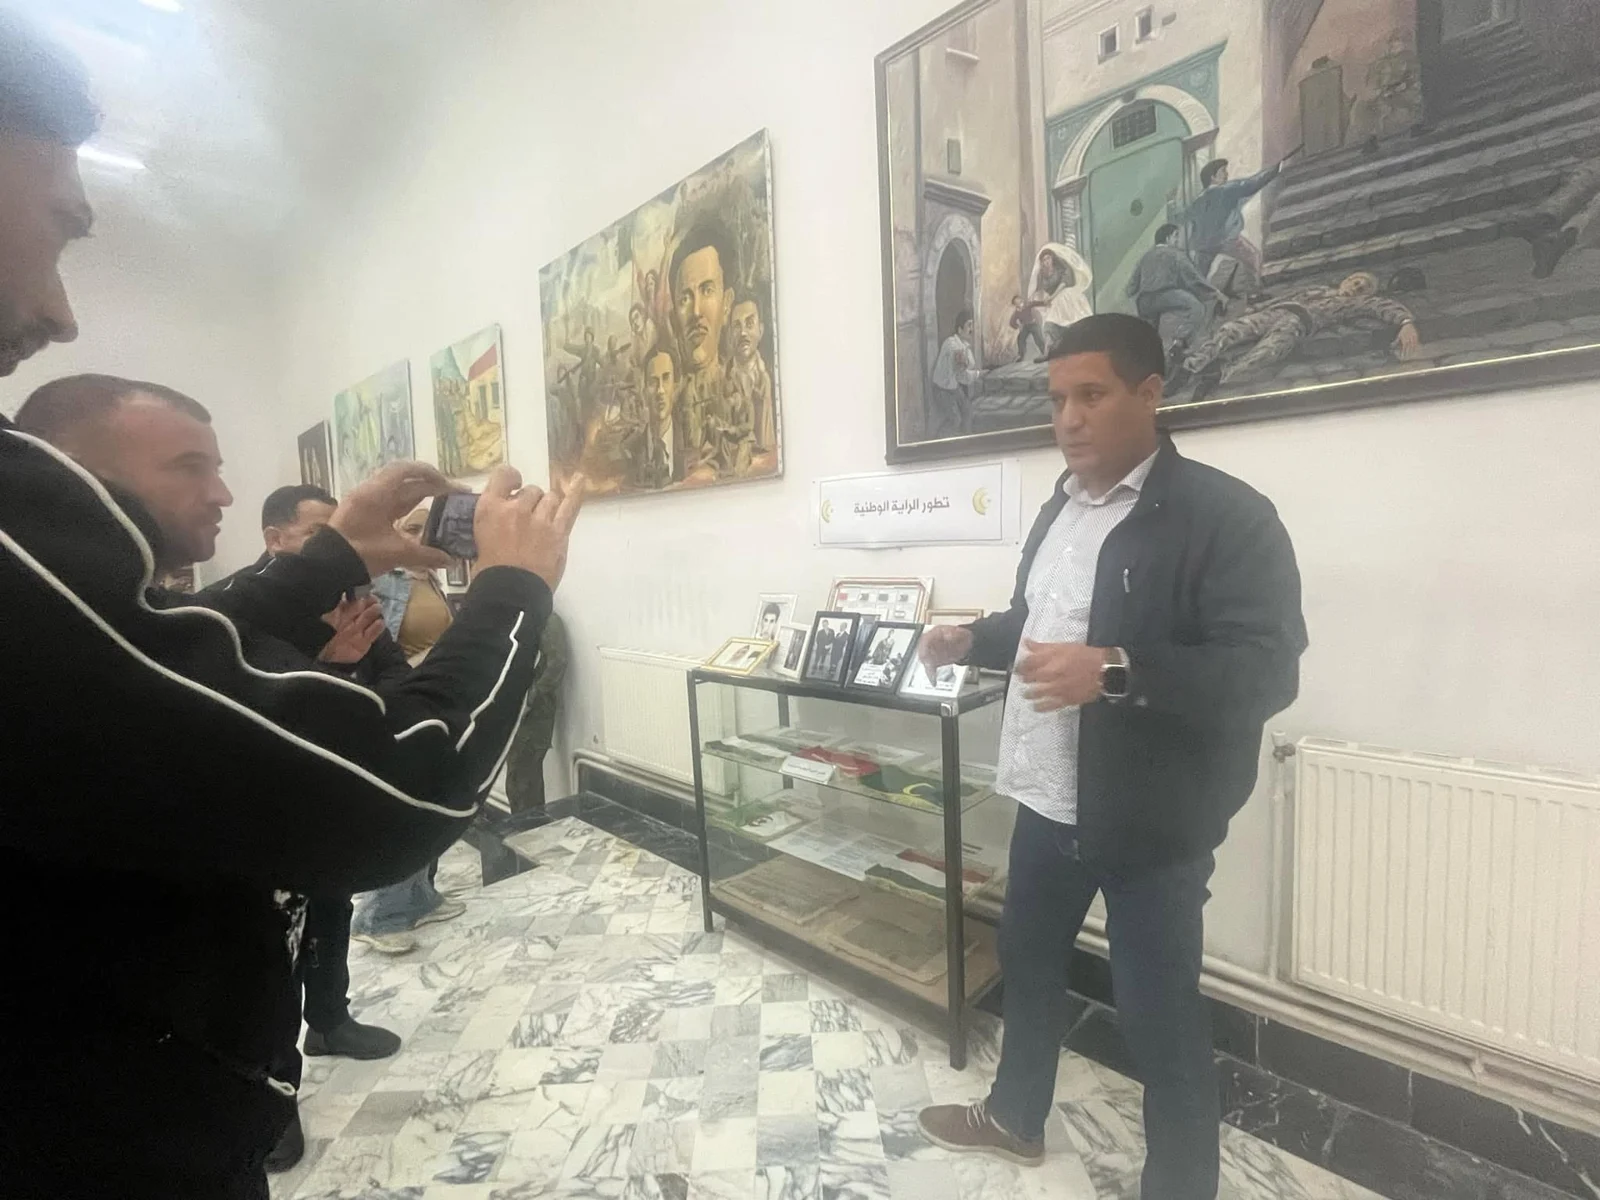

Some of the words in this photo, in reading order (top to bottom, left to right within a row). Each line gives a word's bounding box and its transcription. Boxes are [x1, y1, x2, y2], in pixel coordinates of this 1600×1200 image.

[853, 500, 889, 516] الوطنية
[891, 498, 919, 514] الراية
[921, 496, 950, 513] تطور
